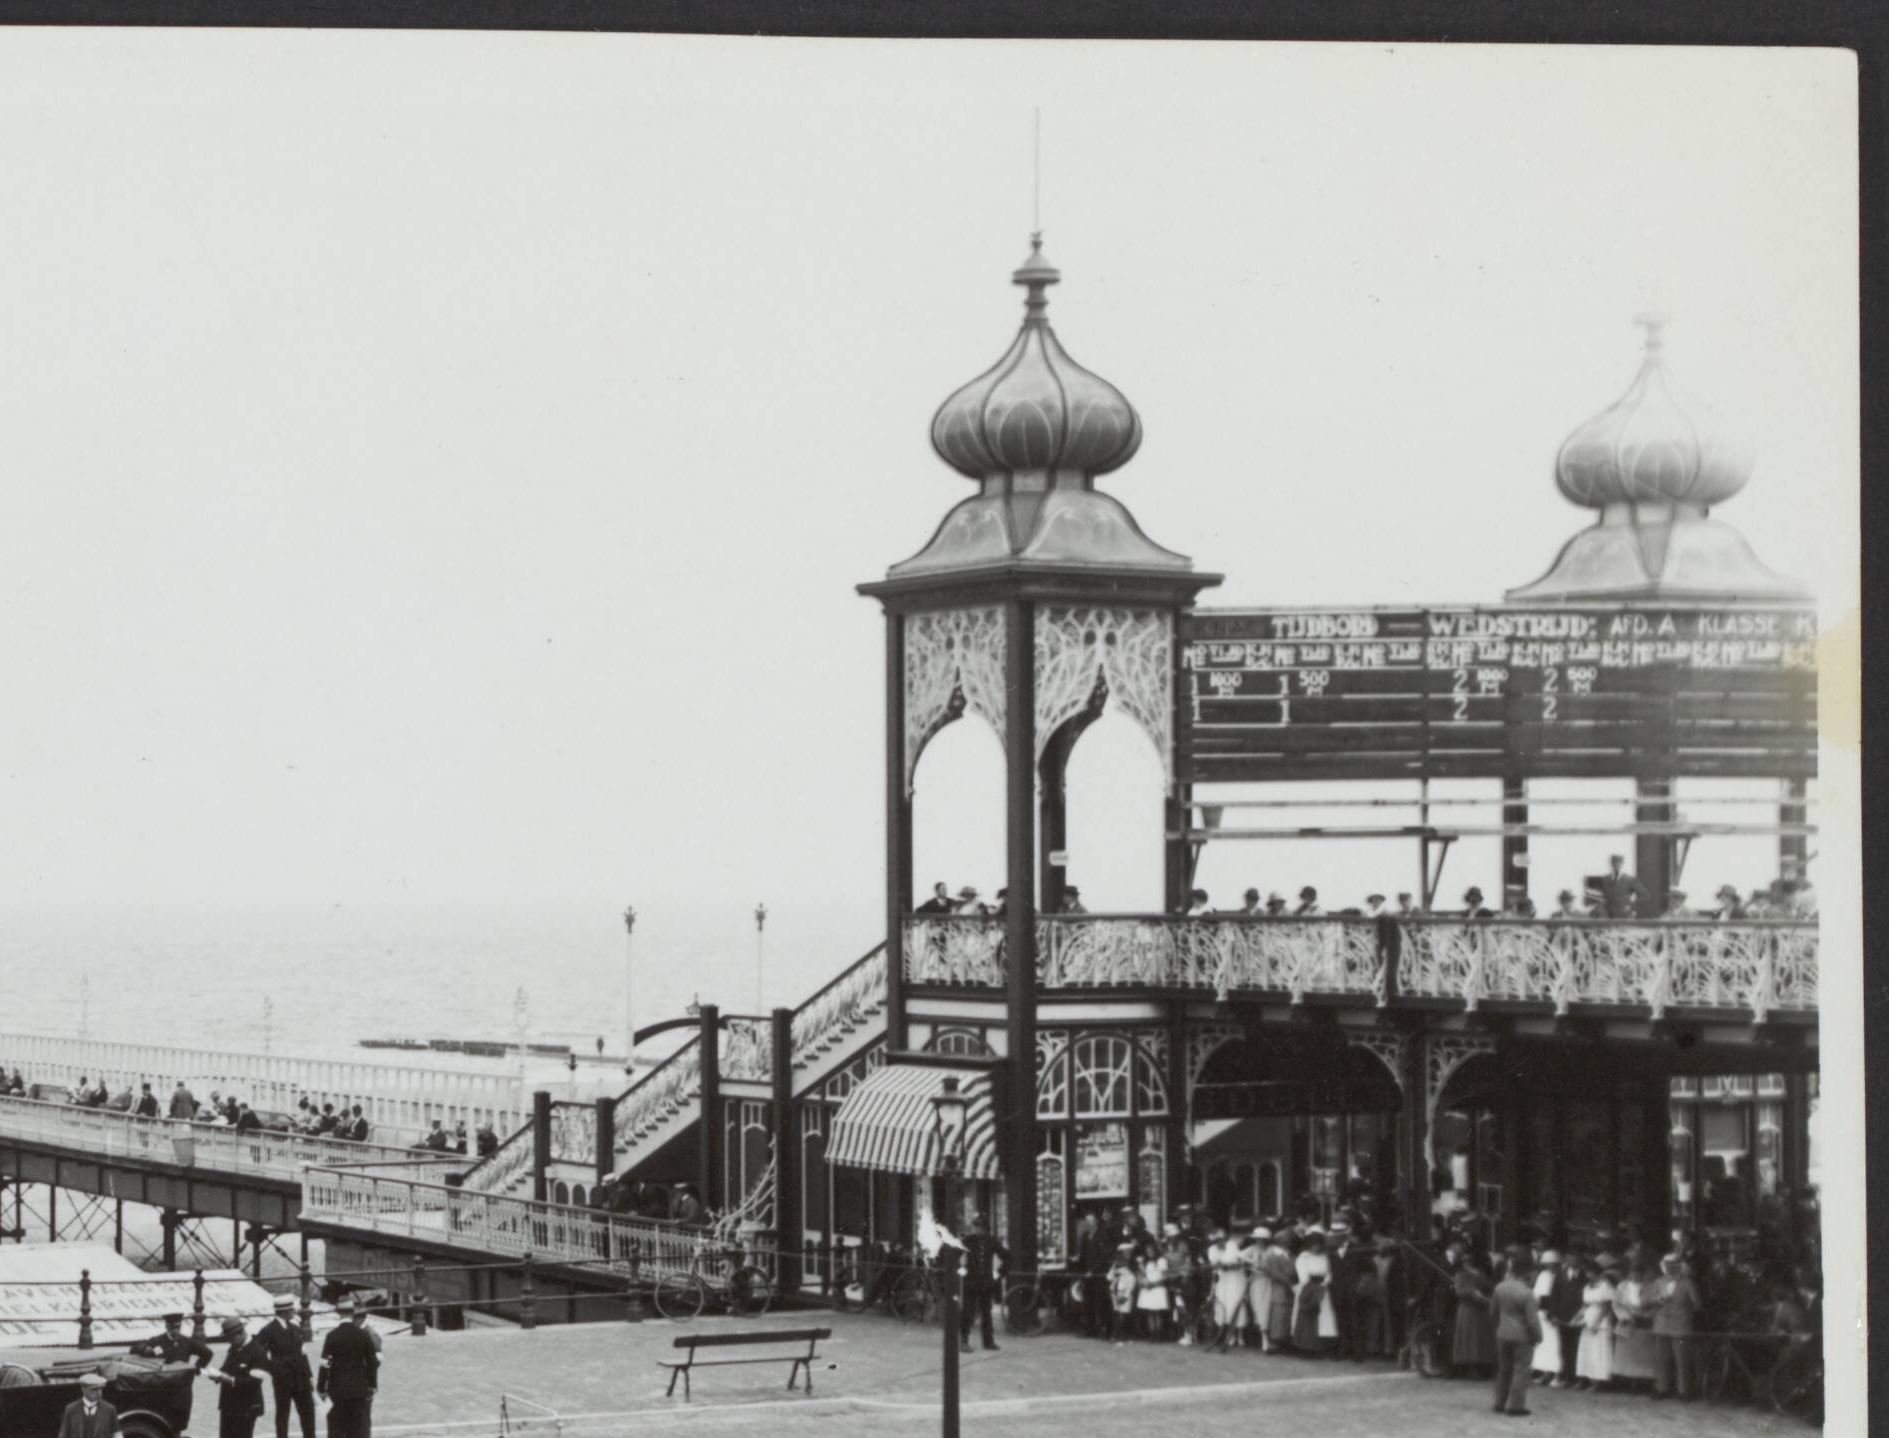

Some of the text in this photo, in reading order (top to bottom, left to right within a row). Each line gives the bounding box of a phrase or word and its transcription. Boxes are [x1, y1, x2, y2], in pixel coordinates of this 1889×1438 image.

[1299, 669, 1330, 687] 500
[1543, 667, 1559, 694] 2
[1542, 695, 1558, 721] 2
